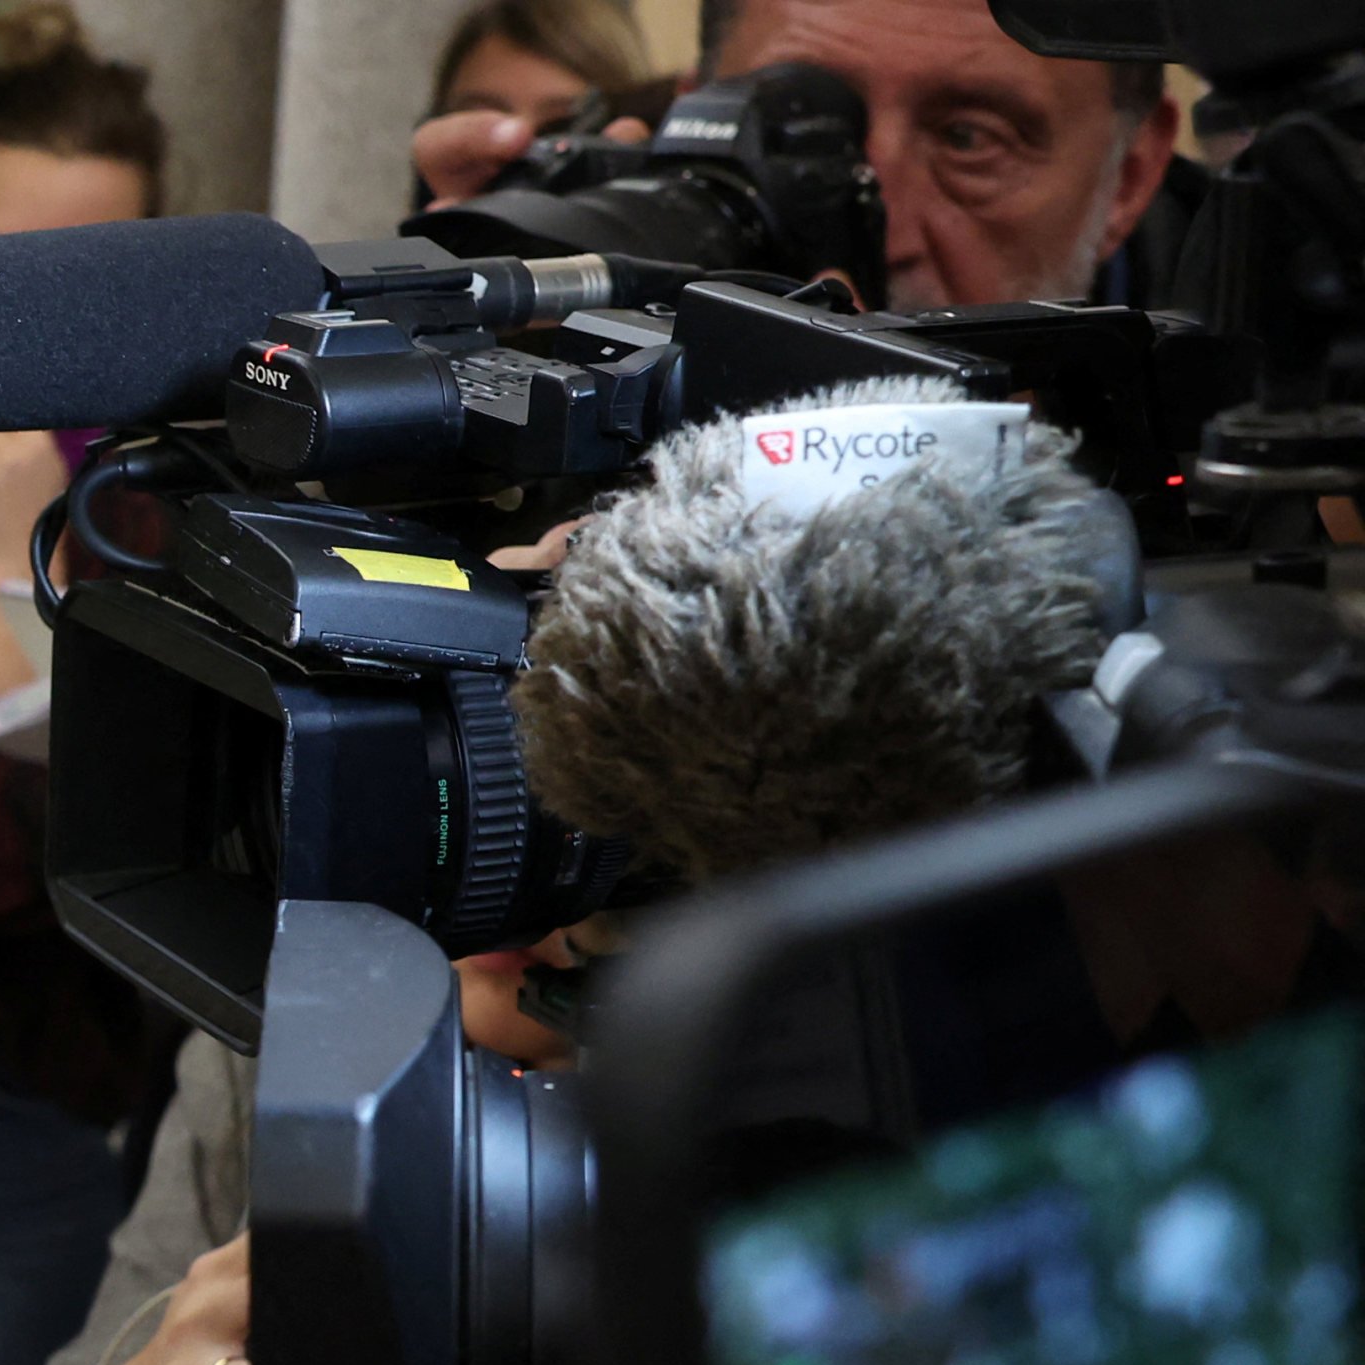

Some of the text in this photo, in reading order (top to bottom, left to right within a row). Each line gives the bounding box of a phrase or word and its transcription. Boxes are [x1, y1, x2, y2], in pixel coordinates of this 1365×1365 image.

[245, 361, 291, 391] SONY
[802, 425, 938, 474] Rycote
[437, 778, 449, 865] FUJINON LENS
